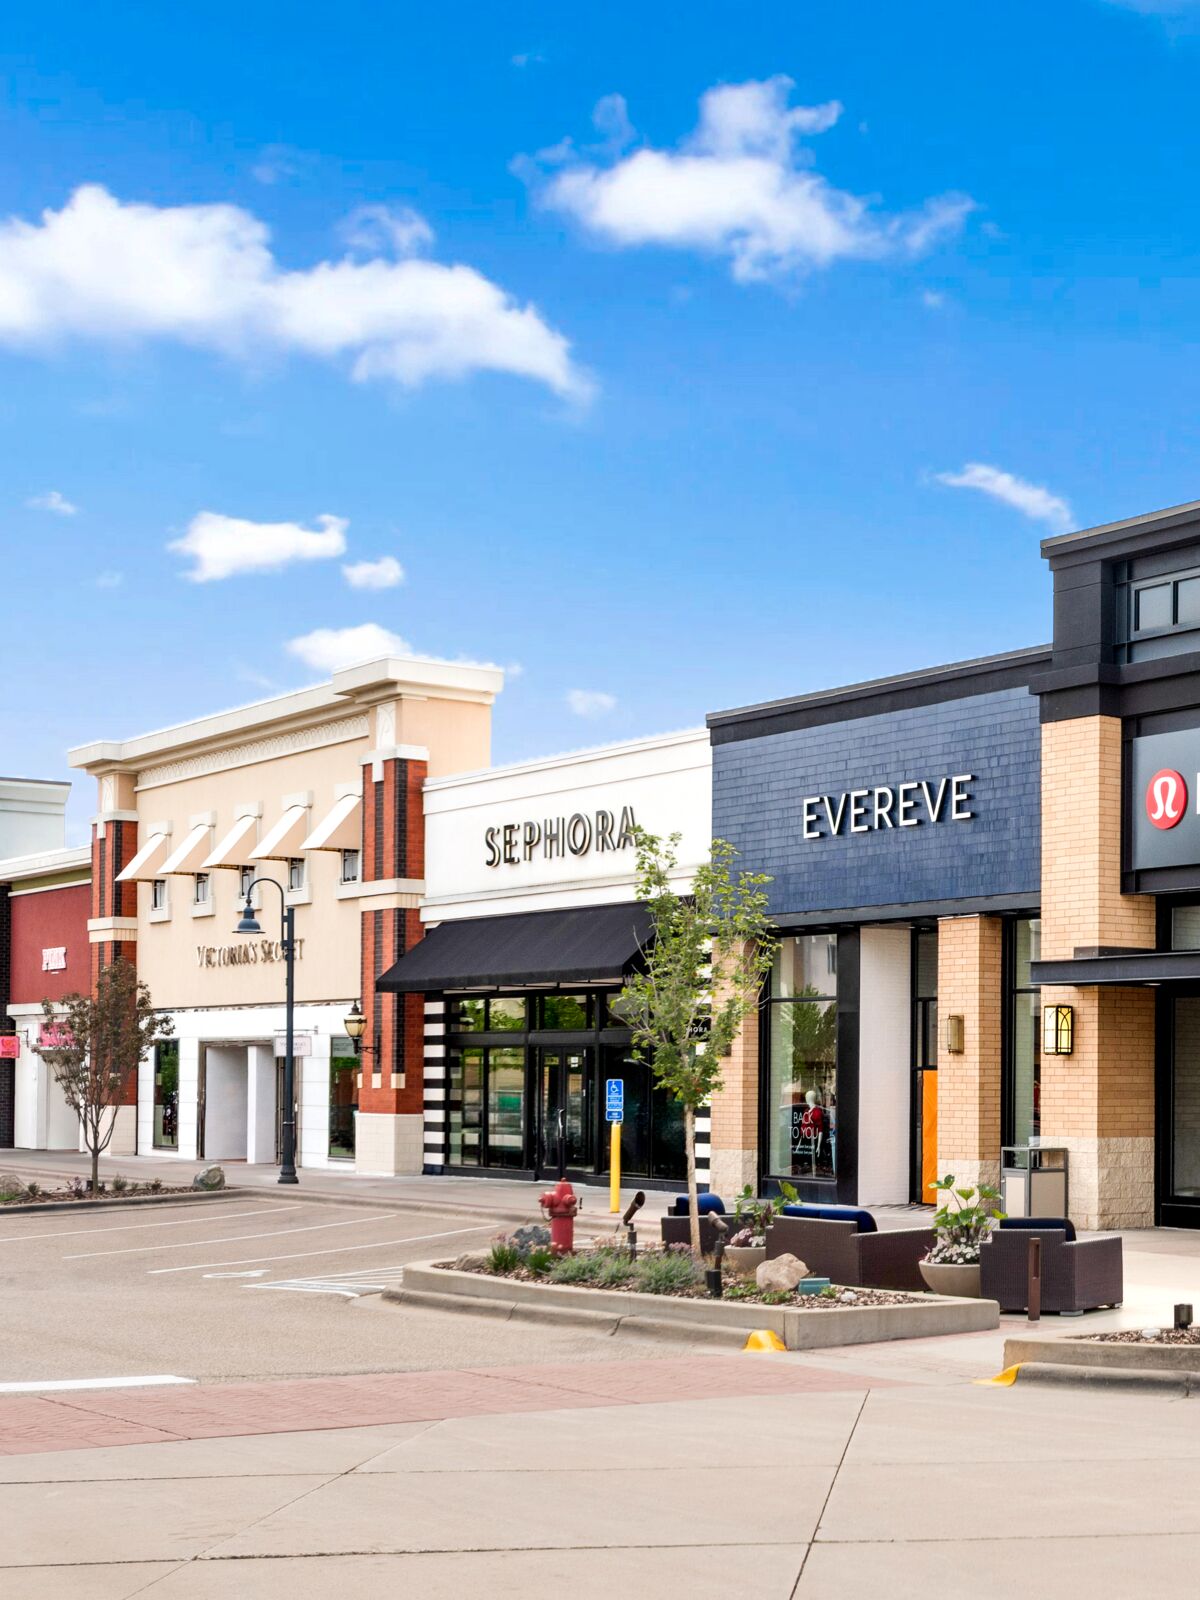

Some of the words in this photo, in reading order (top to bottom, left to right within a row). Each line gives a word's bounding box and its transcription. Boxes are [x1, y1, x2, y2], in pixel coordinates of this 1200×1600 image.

[803, 774, 973, 839] EVEREVE
[485, 805, 636, 868] SEPHORA
[196, 941, 258, 968] VICTORIA'S
[260, 938, 304, 963] SECT
[788, 1126, 800, 1139] TO
[801, 1126, 819, 1139] YOU
[793, 1111, 814, 1124] BACK
